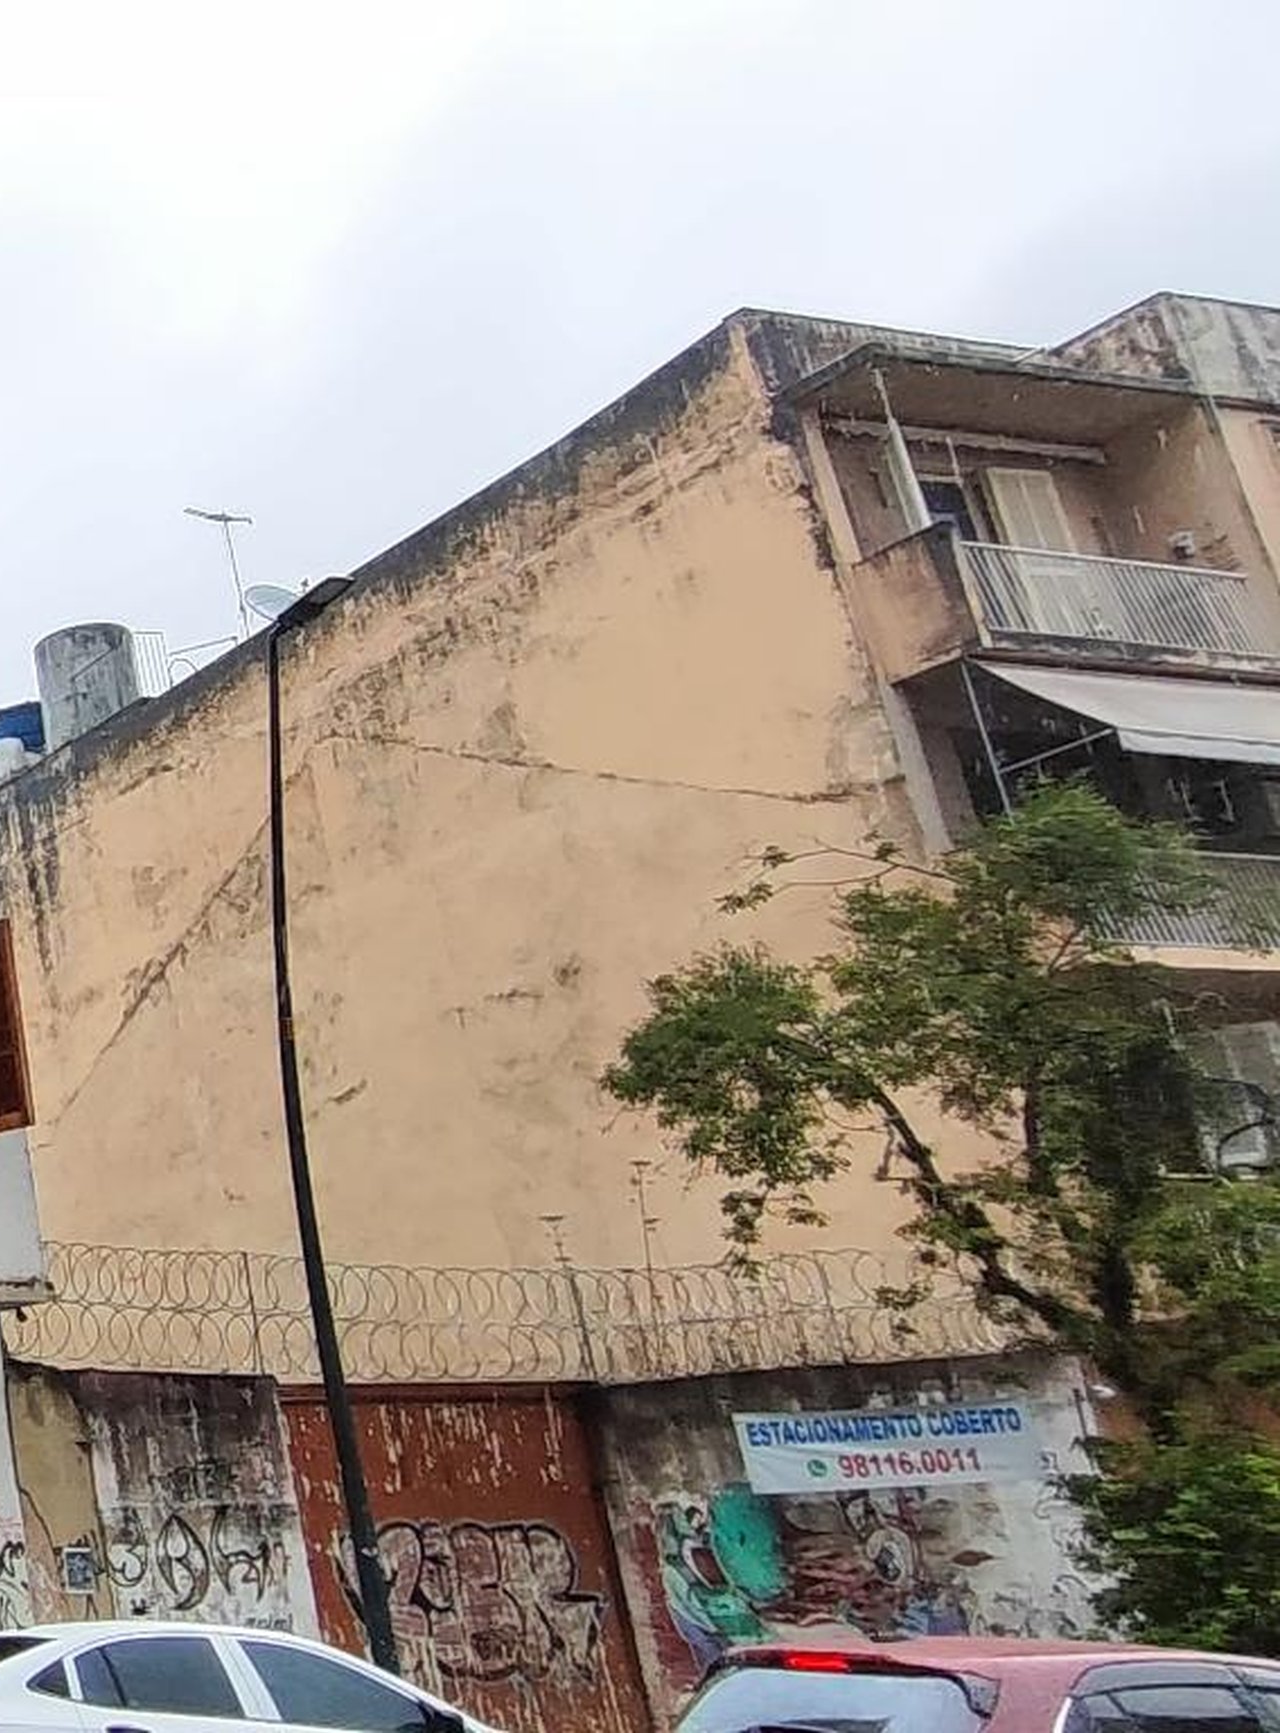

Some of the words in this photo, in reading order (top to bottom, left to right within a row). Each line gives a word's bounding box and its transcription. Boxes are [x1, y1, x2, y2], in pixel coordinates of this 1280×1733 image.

[746, 1413, 922, 1447] ESTACIONAMENTO
[928, 1407, 1022, 1435] COBERTO
[838, 1447, 981, 1478] 98116.0011
